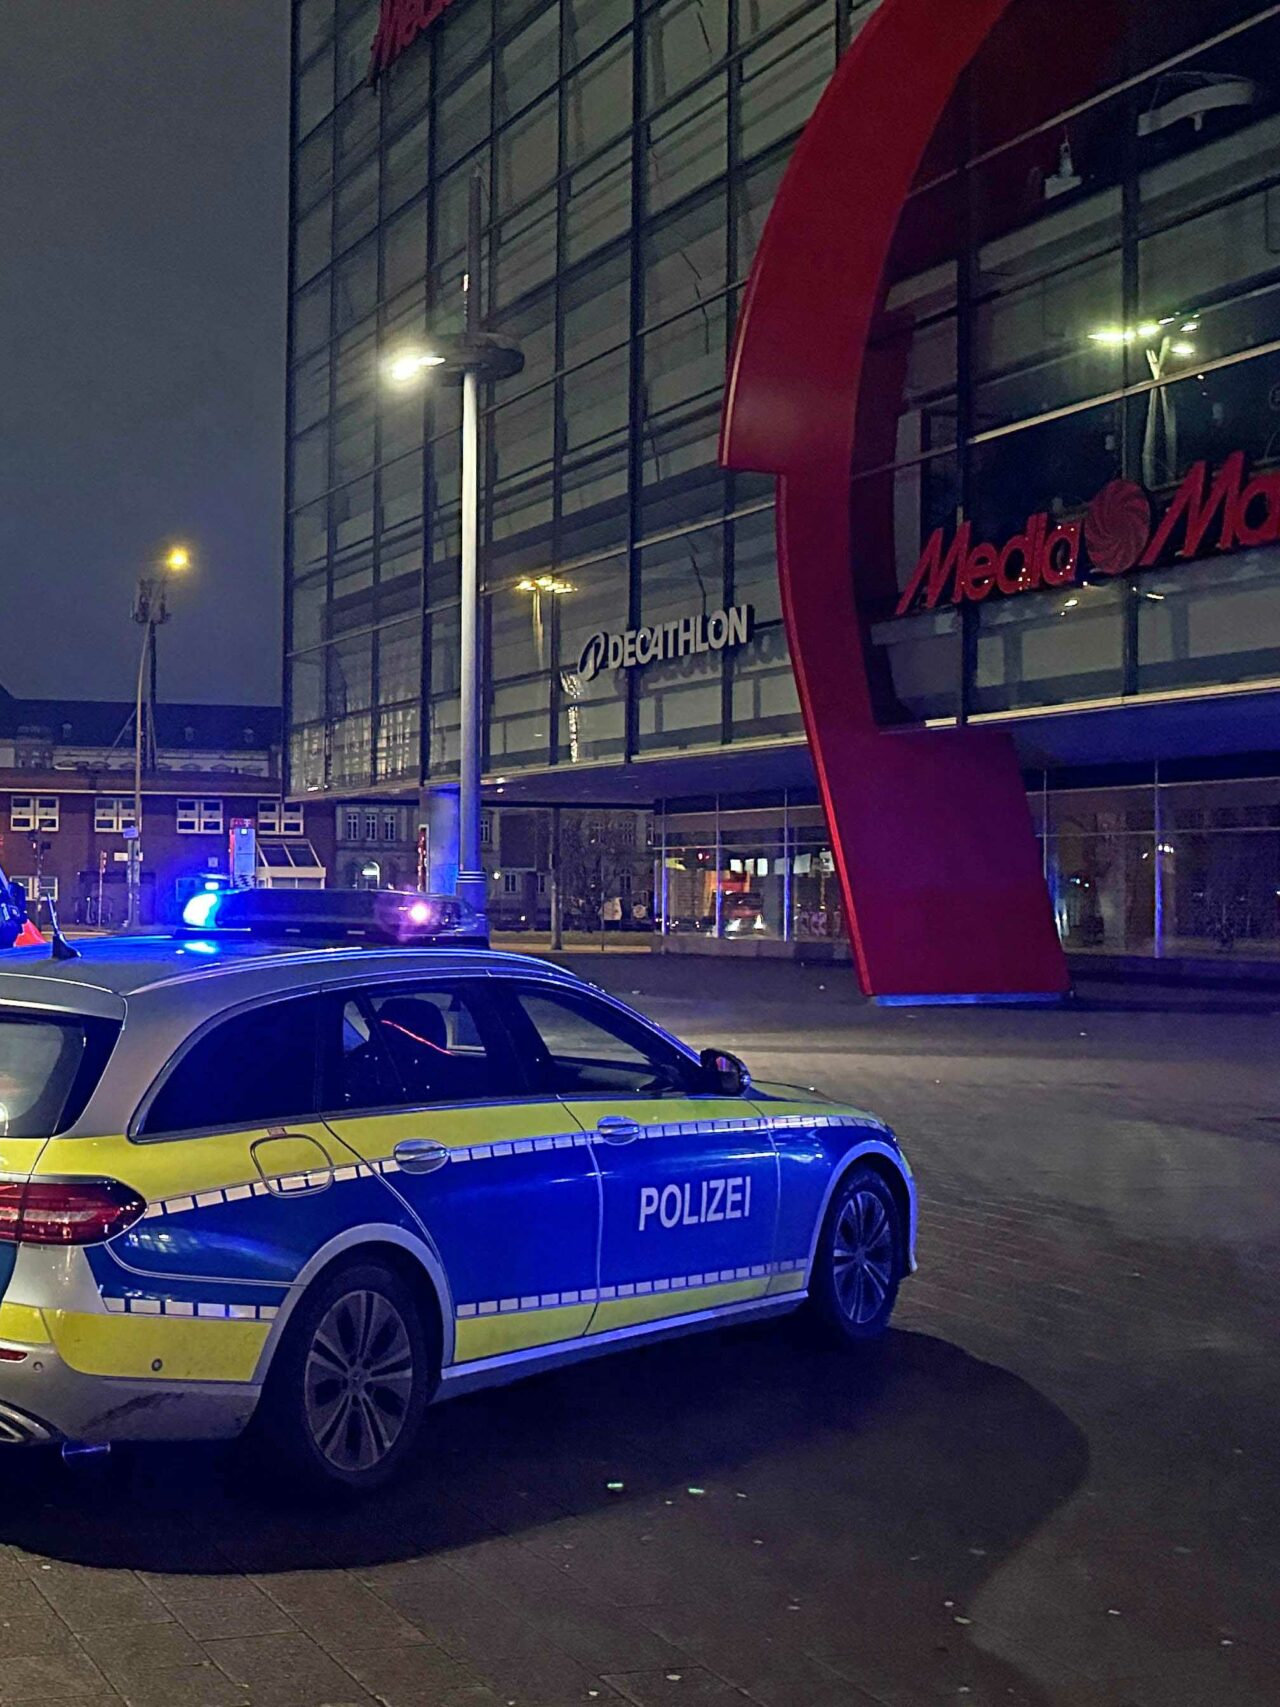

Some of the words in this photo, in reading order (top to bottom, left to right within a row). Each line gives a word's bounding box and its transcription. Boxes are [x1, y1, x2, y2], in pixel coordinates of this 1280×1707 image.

[895, 513, 1081, 615] Media
[606, 604, 752, 670] DECATHLON
[638, 1175, 752, 1232] POLIZEI
